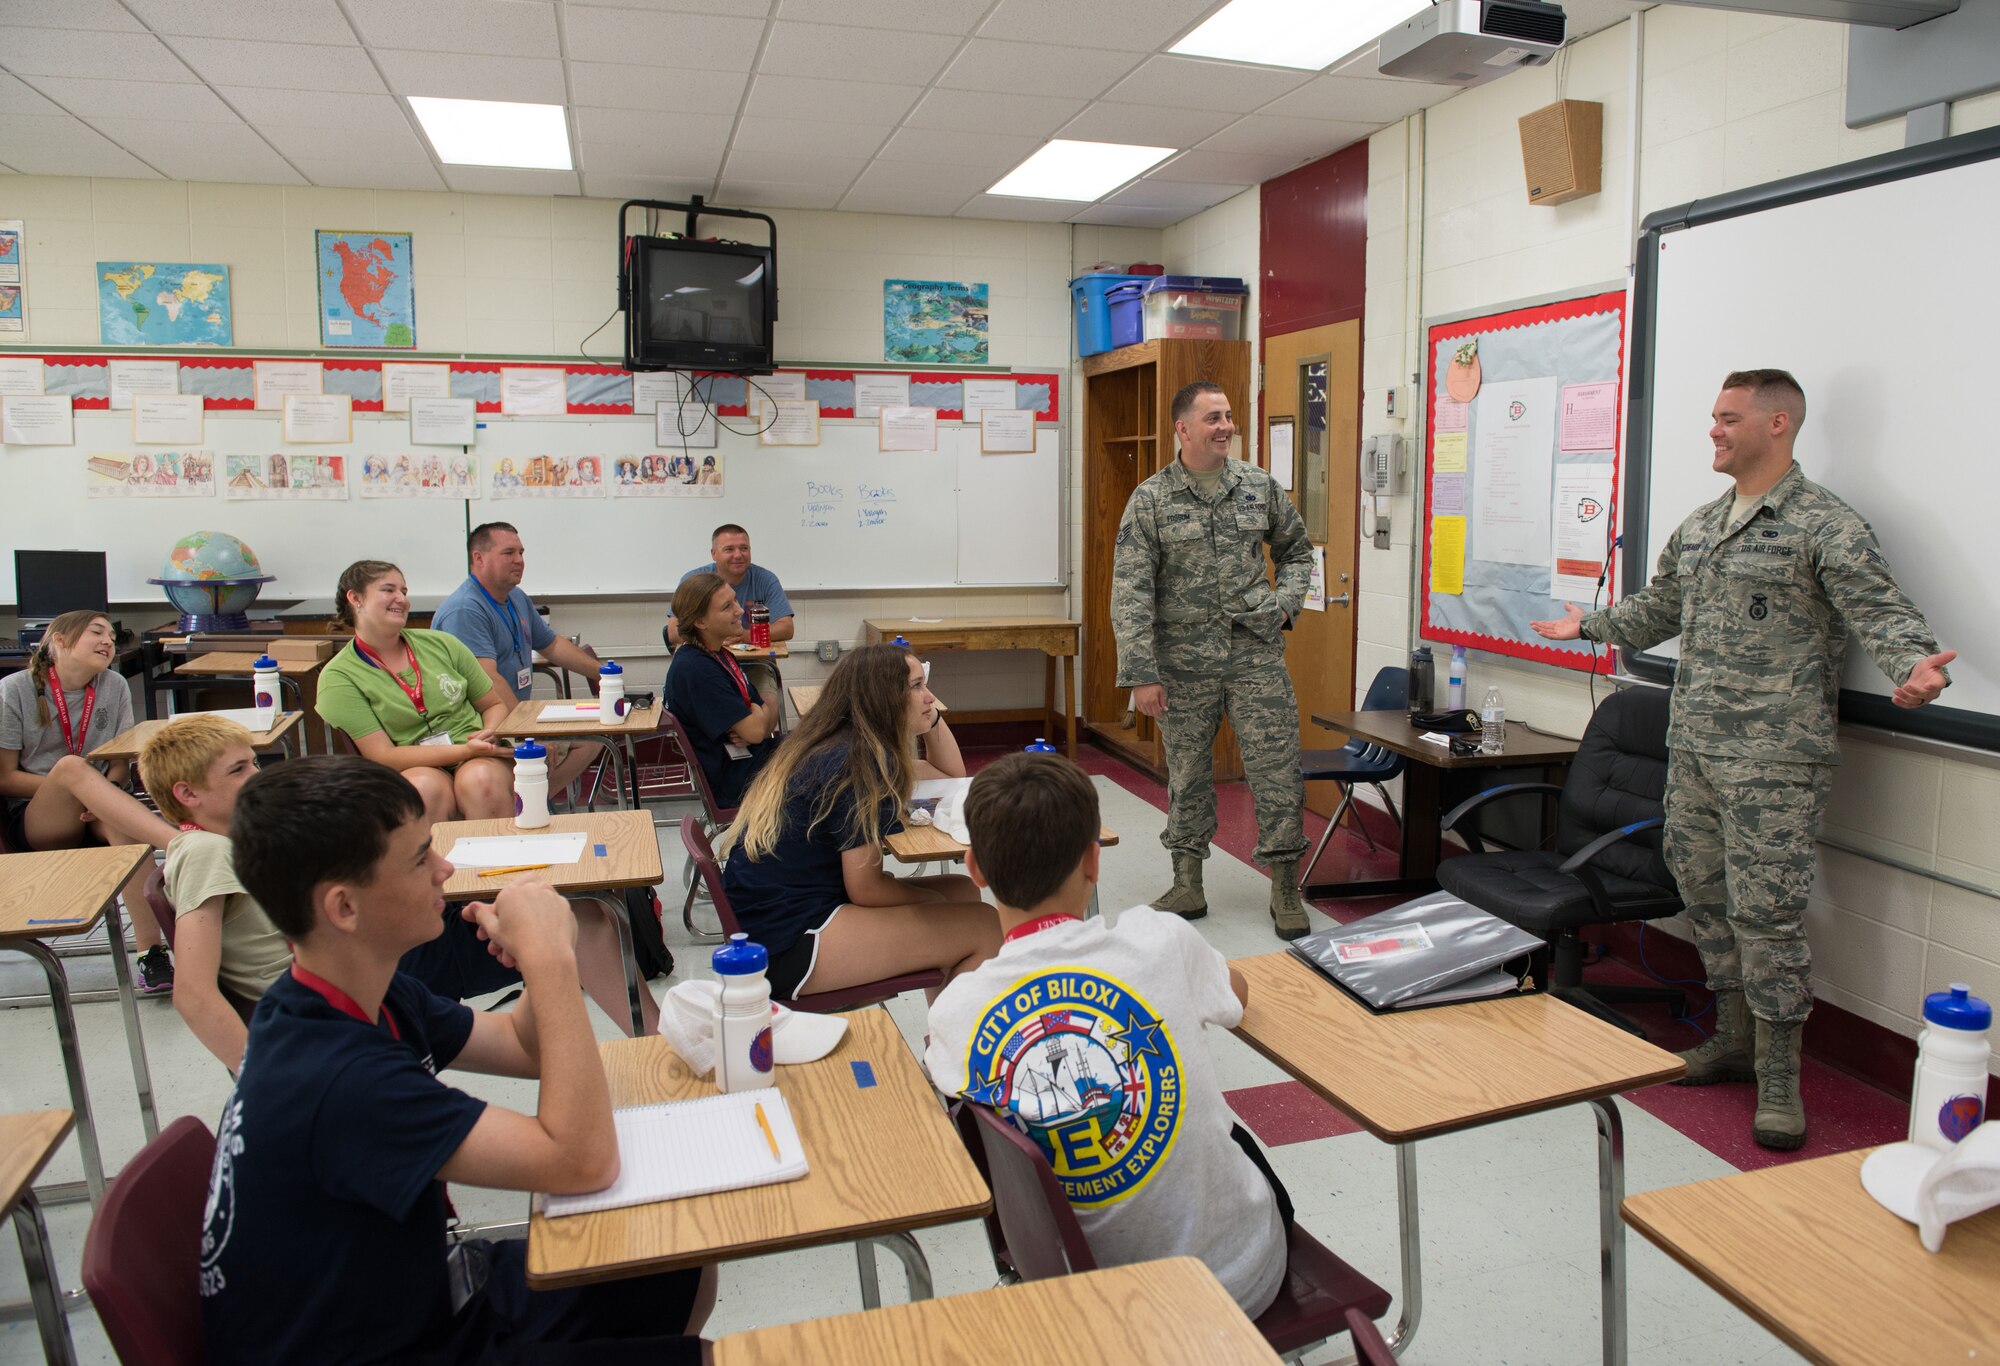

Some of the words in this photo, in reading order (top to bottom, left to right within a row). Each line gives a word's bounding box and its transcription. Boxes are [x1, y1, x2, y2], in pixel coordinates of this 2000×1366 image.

[902, 283, 943, 292] Geography
[947, 284, 969, 292] Terms
[806, 481, 844, 499] Books
[1584, 504, 1596, 515] B
[1766, 545, 1792, 557] FORCE
[976, 1005, 1011, 1055] CITY
[1014, 985, 1042, 1013] OF
[1046, 978, 1121, 1010] BILOXI
[1060, 1169, 1127, 1197] EMENT
[1125, 1065, 1176, 1175] EXPLORERS
